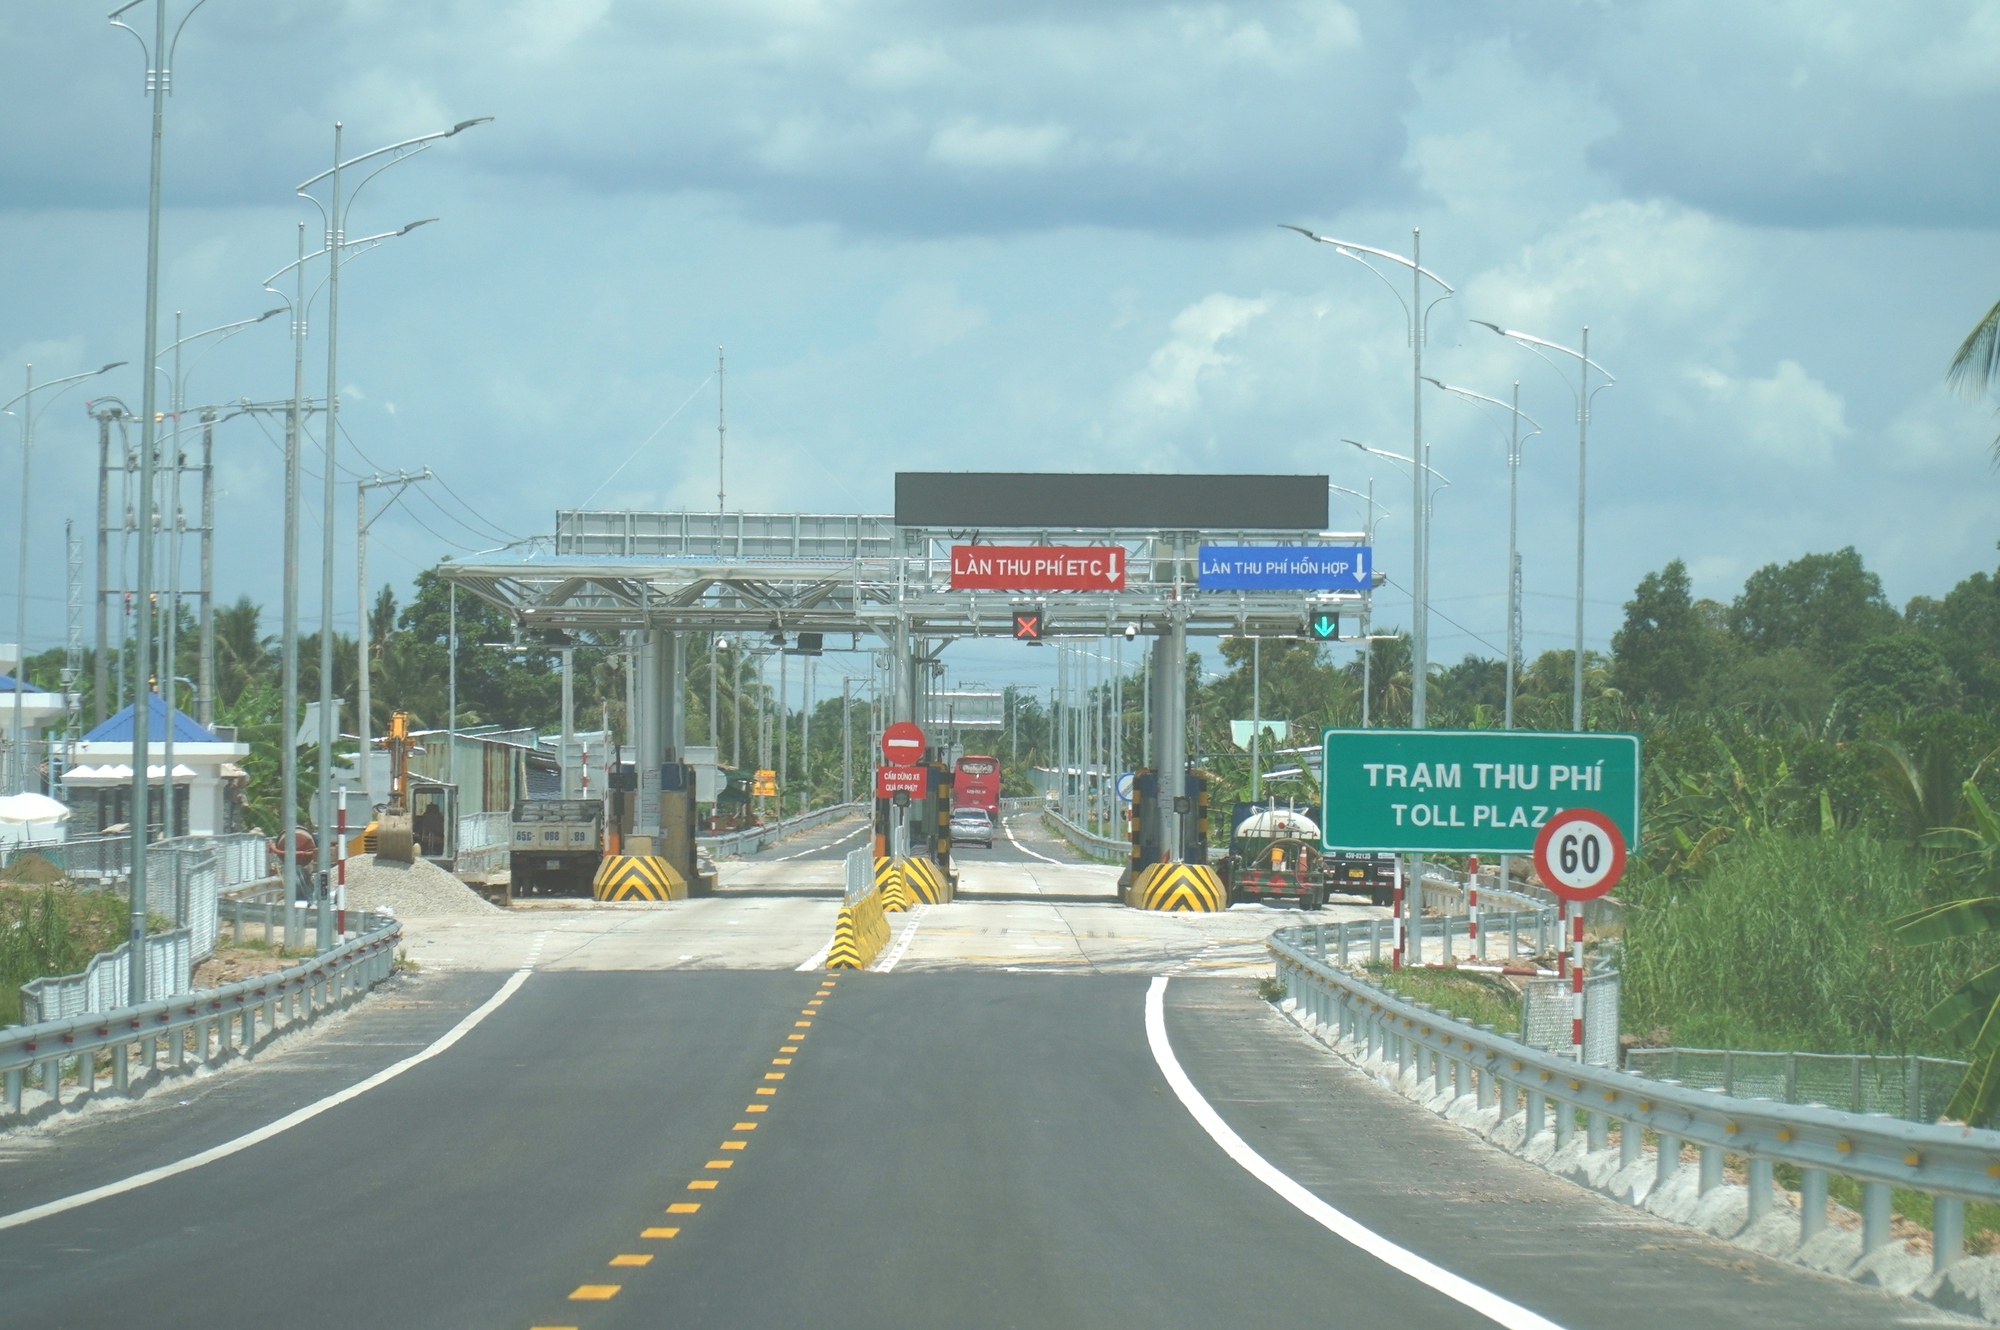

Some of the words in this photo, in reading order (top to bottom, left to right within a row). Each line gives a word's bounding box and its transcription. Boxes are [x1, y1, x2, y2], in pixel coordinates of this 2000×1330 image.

[954, 553, 992, 575] LÀN
[996, 559, 1031, 576] THU
[1035, 554, 1065, 576] PHÍ
[1066, 560, 1102, 576] ETC
[1202, 558, 1231, 575] LÀN
[1234, 562, 1262, 575] THU
[1266, 558, 1288, 574] PHÍ
[1290, 556, 1318, 575] HỖN
[1321, 562, 1349, 577] HỢP
[885, 783, 896, 792] QUÁ
[913, 773, 920, 781] XE
[1363, 762, 1461, 793] TRẠM
[1472, 763, 1539, 790] THU
[1549, 759, 1605, 791] PHÍ
[1391, 803, 1465, 827] TOLL
[1473, 805, 1564, 828] PLAZ
[1560, 834, 1600, 874] 60
